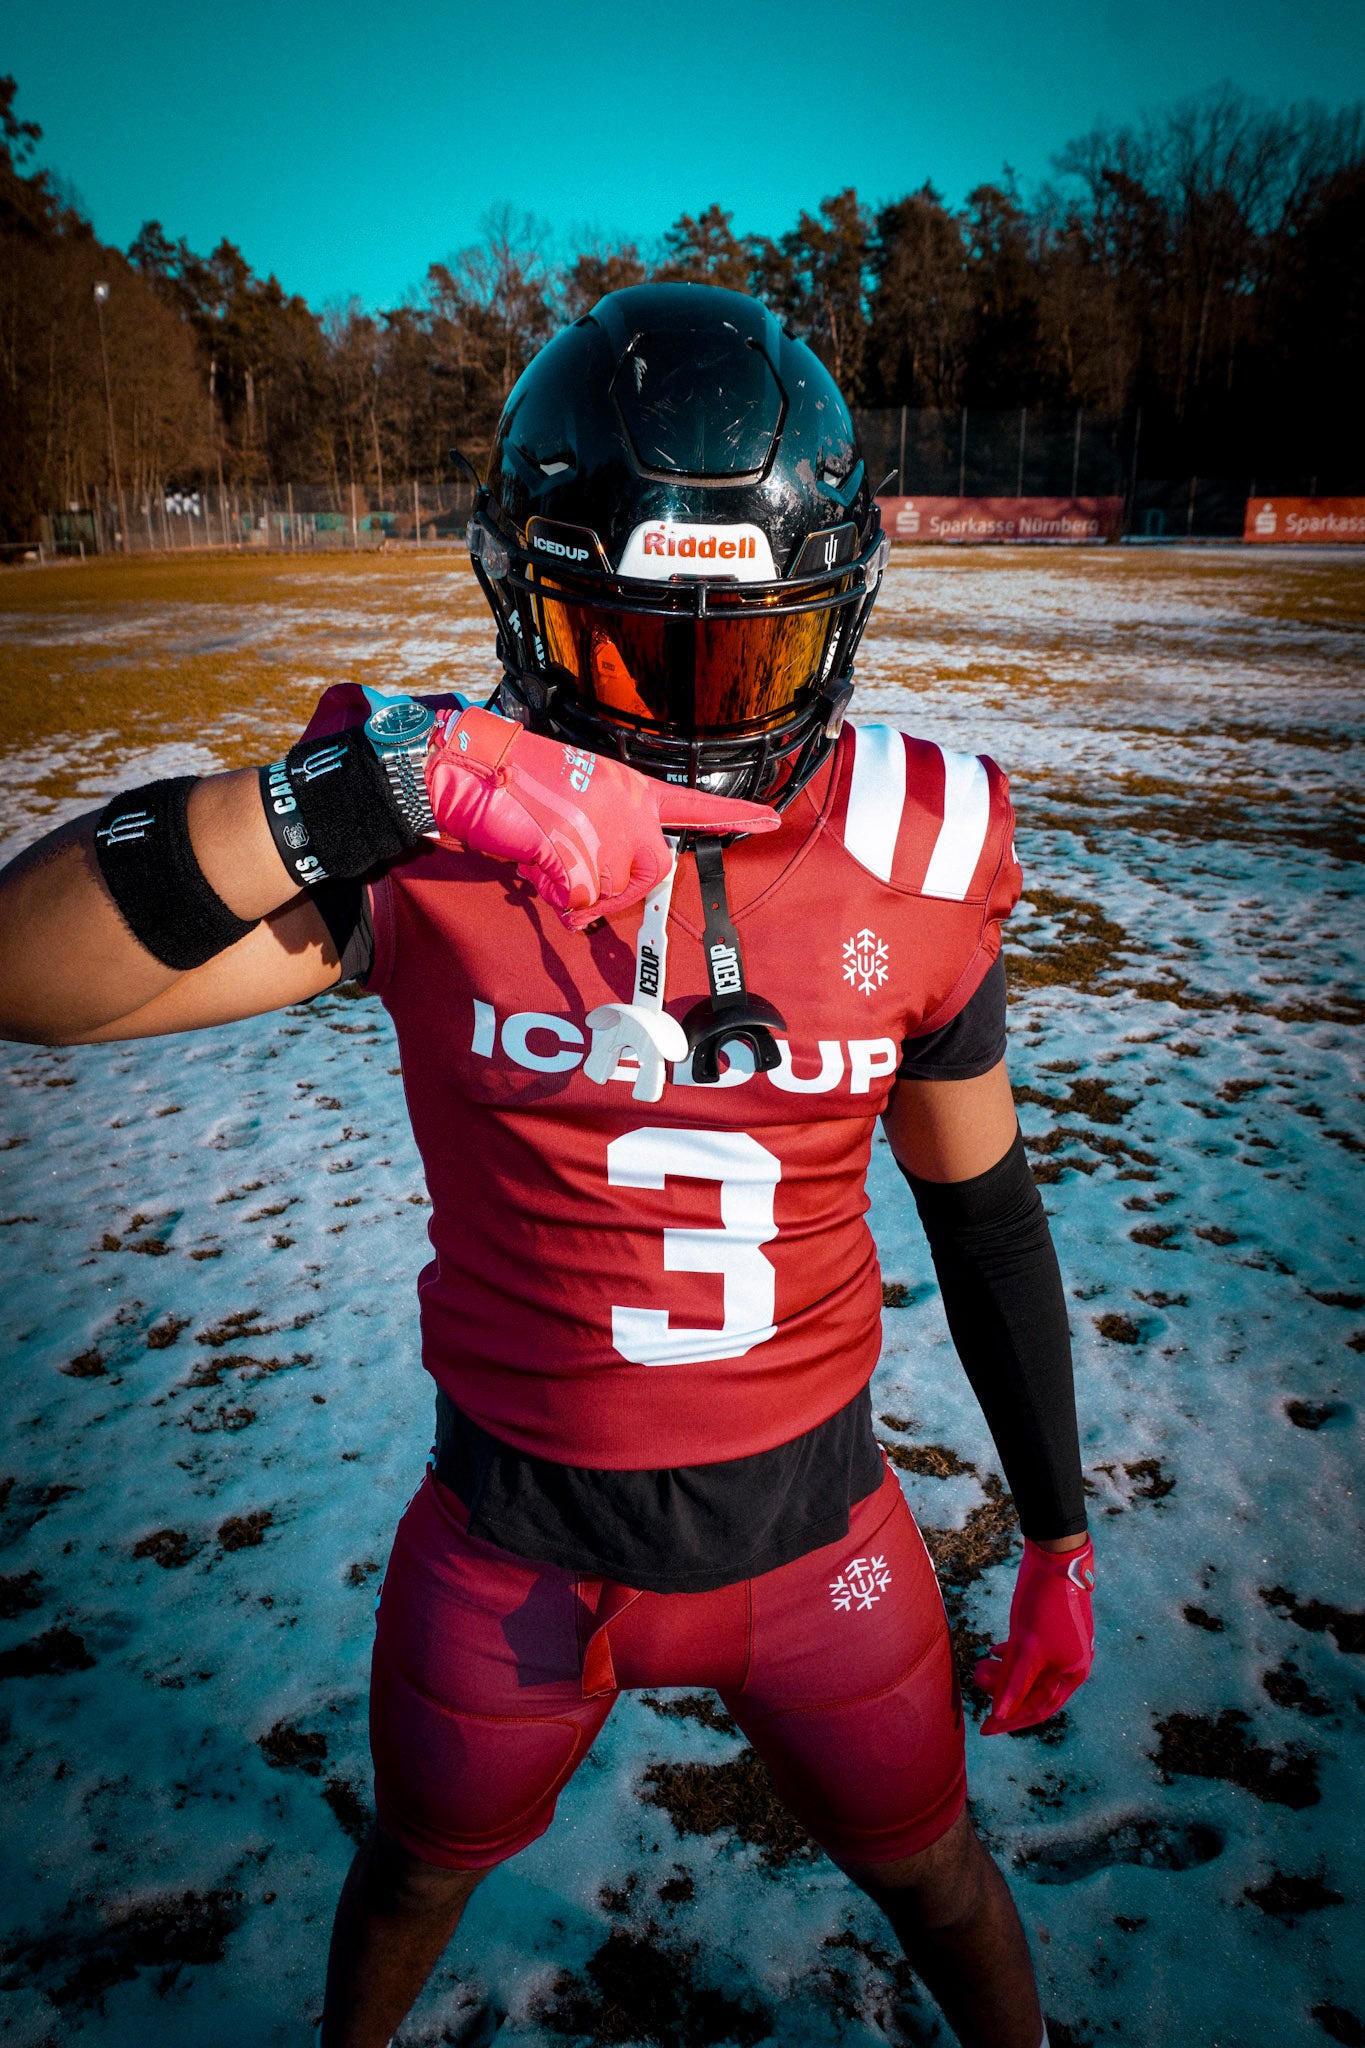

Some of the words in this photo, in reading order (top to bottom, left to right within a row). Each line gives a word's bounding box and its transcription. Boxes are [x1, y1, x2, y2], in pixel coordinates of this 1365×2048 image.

[532, 535, 590, 562] ICEDUP
[643, 529, 757, 560] Riddell
[929, 515, 1015, 536] Sparkasse
[1018, 515, 1099, 536] Nürnberg
[268, 758, 297, 815] CARO
[638, 944, 662, 998] ICEDUP
[709, 943, 742, 997] ICEDUP
[606, 1126, 781, 1366] 3
